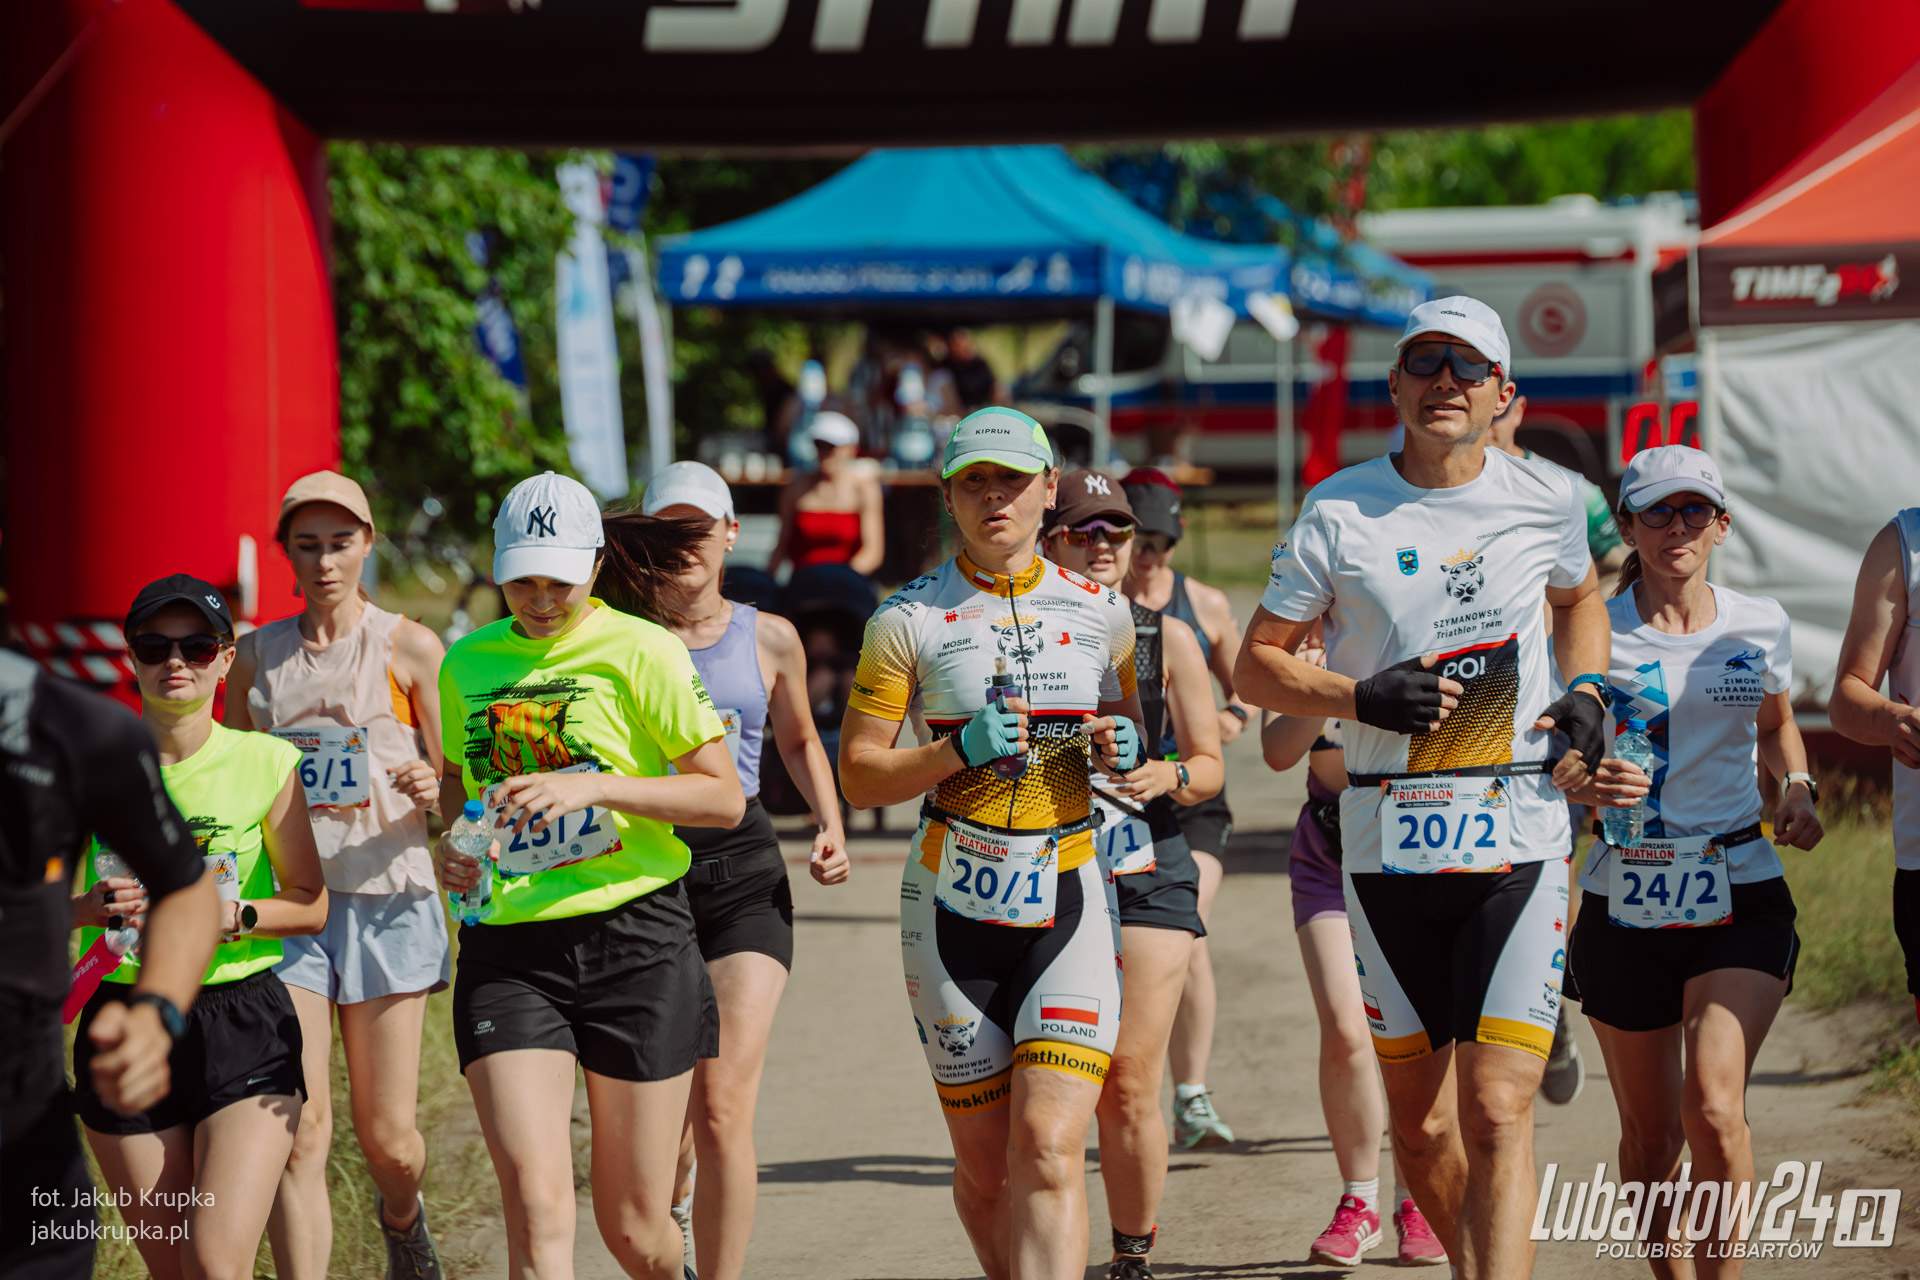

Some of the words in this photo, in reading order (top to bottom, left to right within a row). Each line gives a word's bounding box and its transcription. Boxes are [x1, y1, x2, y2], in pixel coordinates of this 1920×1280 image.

[1084, 474, 1112, 496] NY
[527, 505, 557, 538] NY
[1433, 608, 1502, 629] SZYMANOWSKI
[1436, 626, 1477, 640] Triathlon
[1480, 619, 1503, 631] Team
[942, 637, 972, 650] MOSIR
[984, 671, 1067, 685] SANOWSKI
[1042, 683, 1069, 691] Team
[1391, 789, 1454, 801] TRIATHLON
[1398, 813, 1496, 850] 20/2
[952, 831, 1009, 857] TRIATHLON
[1620, 847, 1676, 859] TRIATHLON
[952, 857, 1042, 905] 20/1
[1623, 870, 1718, 908] 24/2
[1041, 1022, 1098, 1039] POLAND
[935, 1057, 992, 1072] SZYMANOWSKI
[938, 1069, 971, 1079] Triathlon
[973, 1064, 994, 1075] Team
